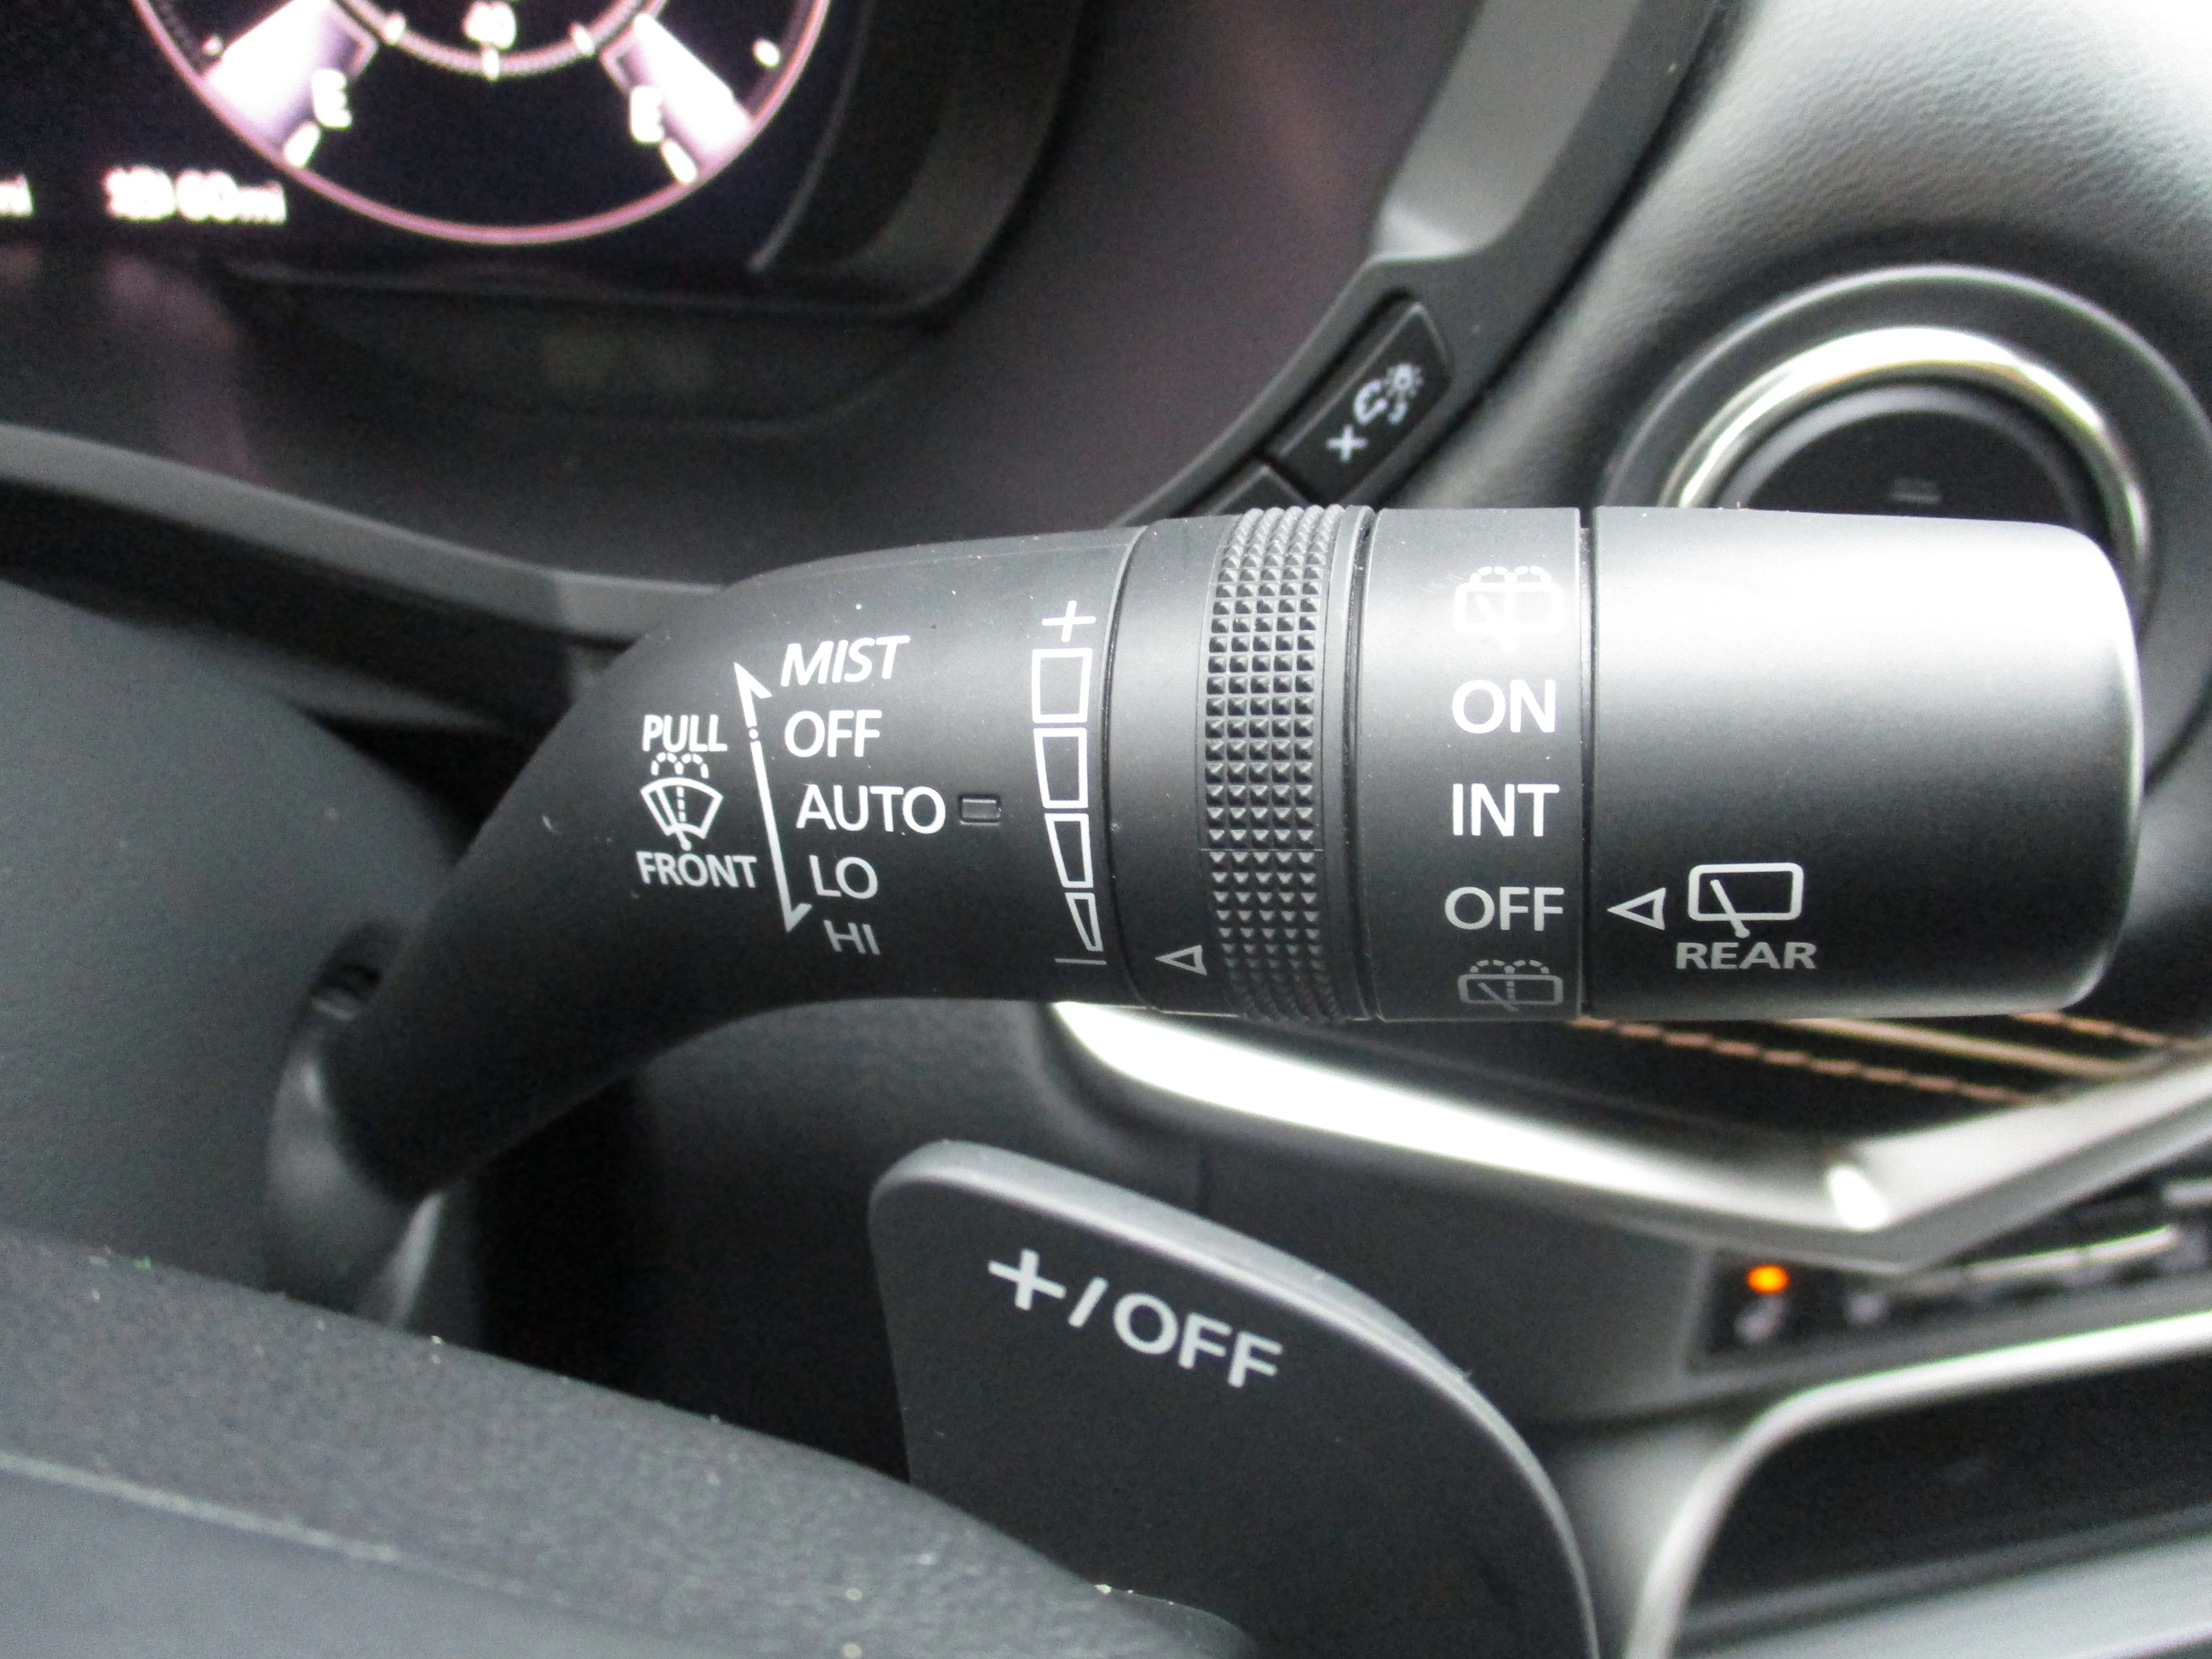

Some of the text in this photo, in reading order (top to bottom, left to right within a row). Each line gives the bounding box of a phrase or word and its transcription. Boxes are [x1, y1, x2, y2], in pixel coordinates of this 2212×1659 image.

[781, 635, 911, 687] MIST
[1452, 679, 1556, 735] ON
[642, 714, 728, 752] PULL
[785, 709, 882, 758] OFF
[796, 786, 946, 834] AUTO
[1452, 784, 1560, 837] INT
[636, 851, 757, 888] FRONT
[809, 857, 878, 899] LO
[1444, 887, 1565, 931] OFF
[823, 920, 880, 955] HI
[1676, 942, 1817, 969] REAR
